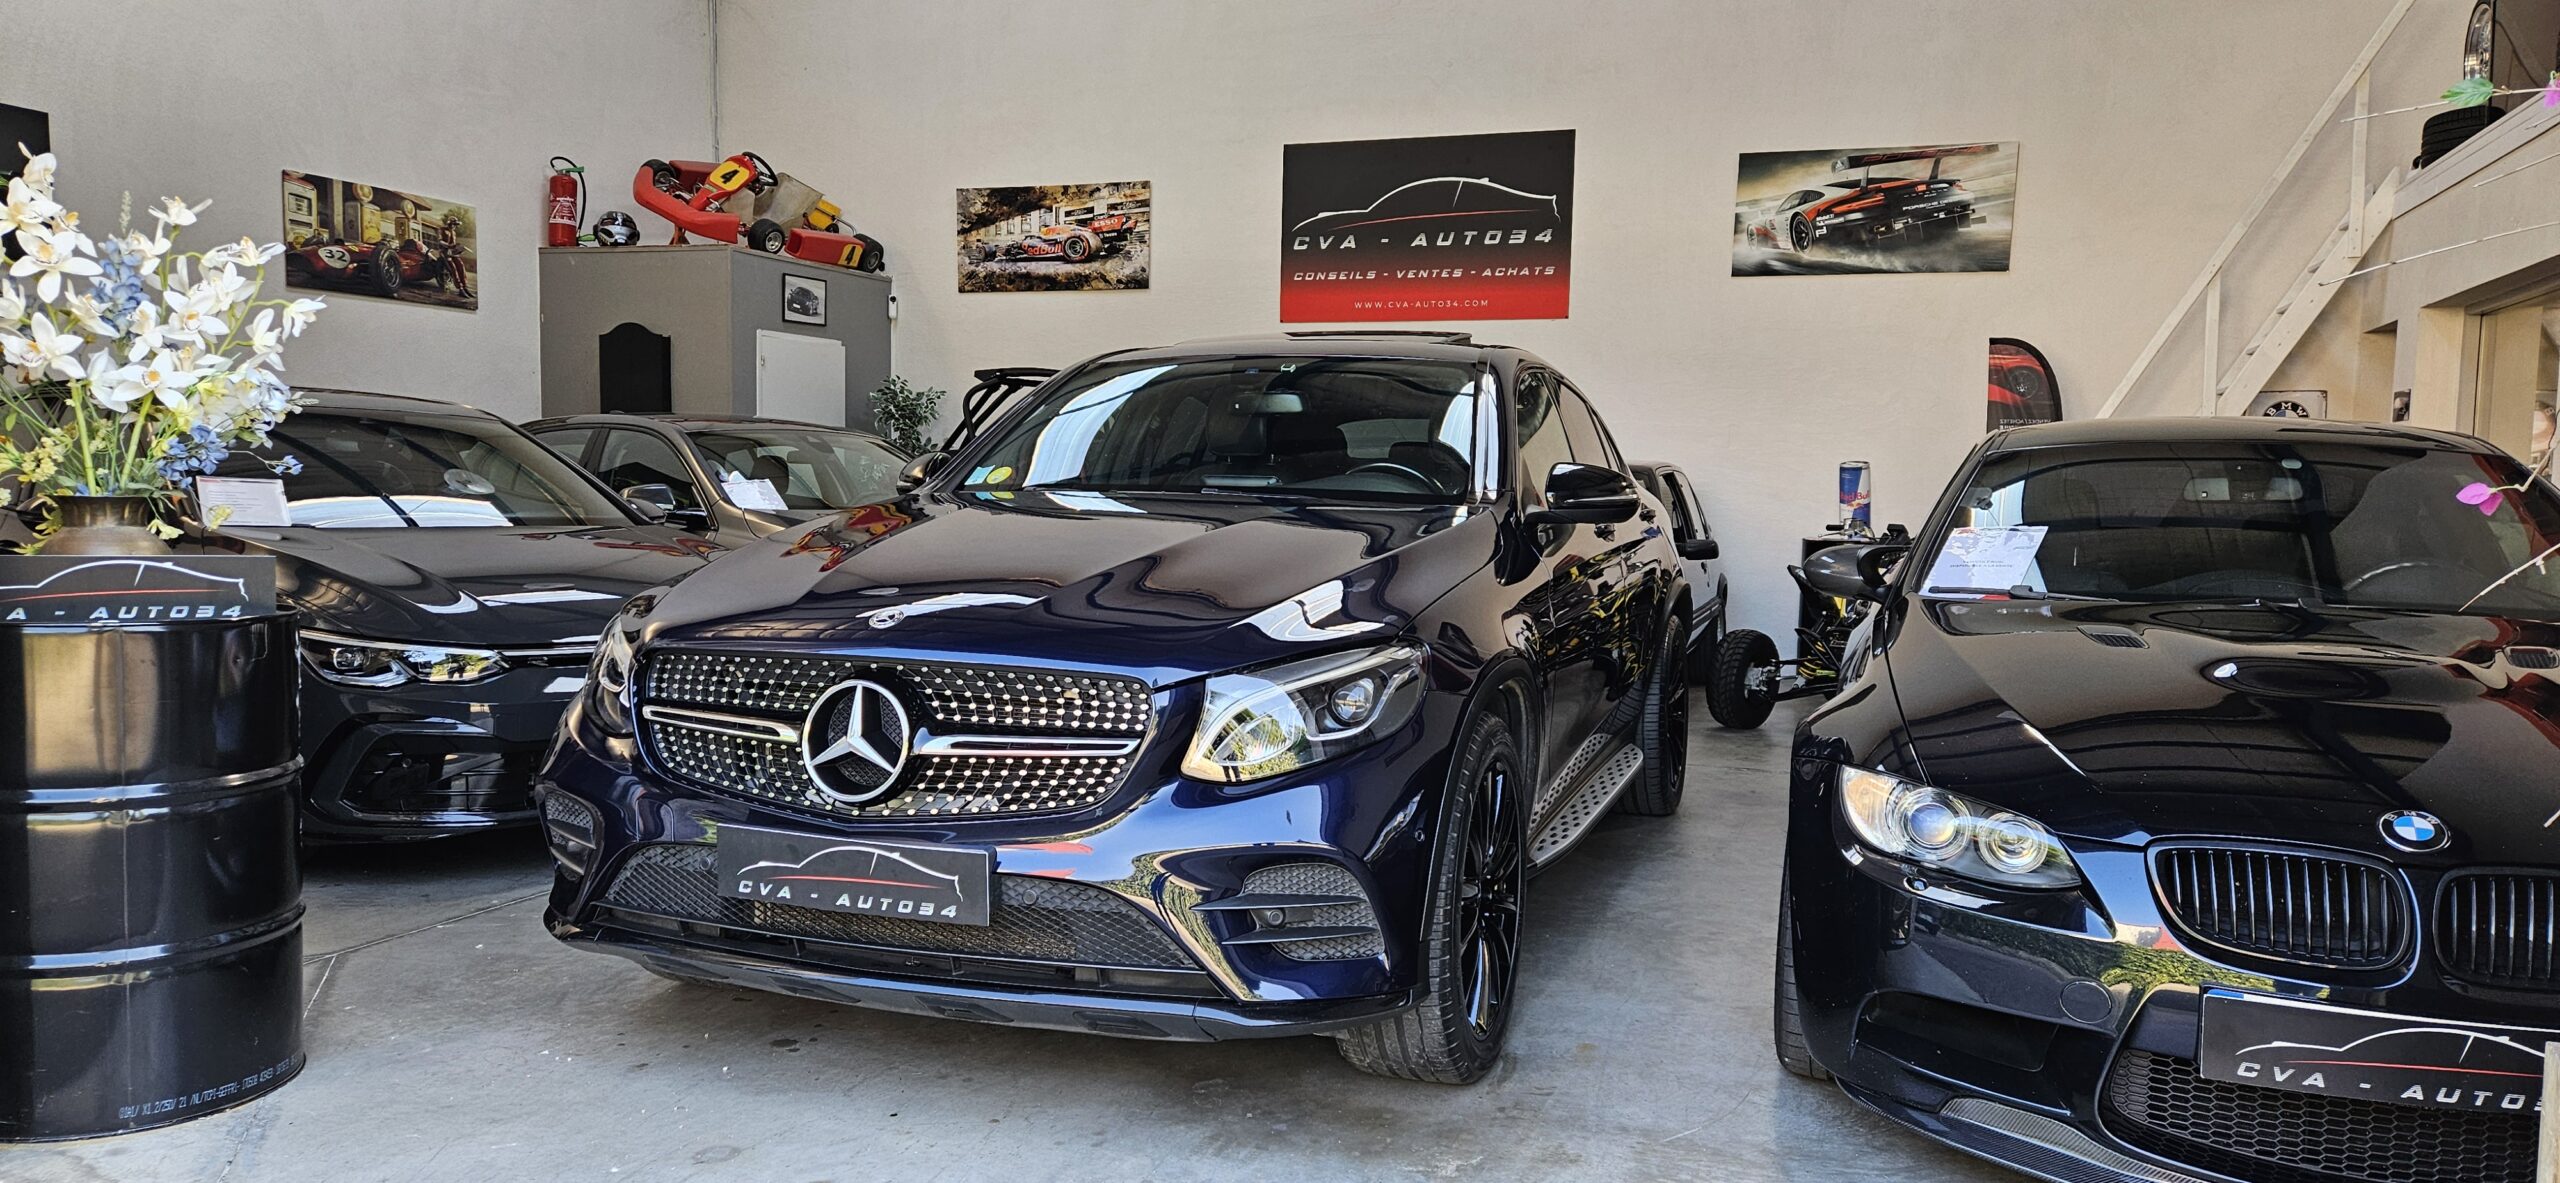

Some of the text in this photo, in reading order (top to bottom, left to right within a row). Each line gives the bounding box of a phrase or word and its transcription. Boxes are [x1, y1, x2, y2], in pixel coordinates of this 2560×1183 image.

[720, 169, 740, 184] 4
[1293, 234, 1356, 251] CVA
[1410, 228, 1554, 247] AUTO34
[324, 248, 347, 262] 32
[845, 246, 857, 265] 4
[1293, 270, 1377, 281] CONSEILS
[1396, 268, 1463, 279] VENTES
[1481, 266, 1556, 277] ACHATS
[1354, 298, 1489, 309] WWW.CVA-AUTO34.COM
[2266, 402, 2307, 417] BMW
[89, 605, 243, 620] AUTO34
[2384, 810, 2439, 825] BMW
[737, 879, 791, 900] CVA
[835, 892, 958, 919] AUTO34
[2236, 1061, 2325, 1089] CVA
[2400, 1084, 2544, 1112] AUTO
